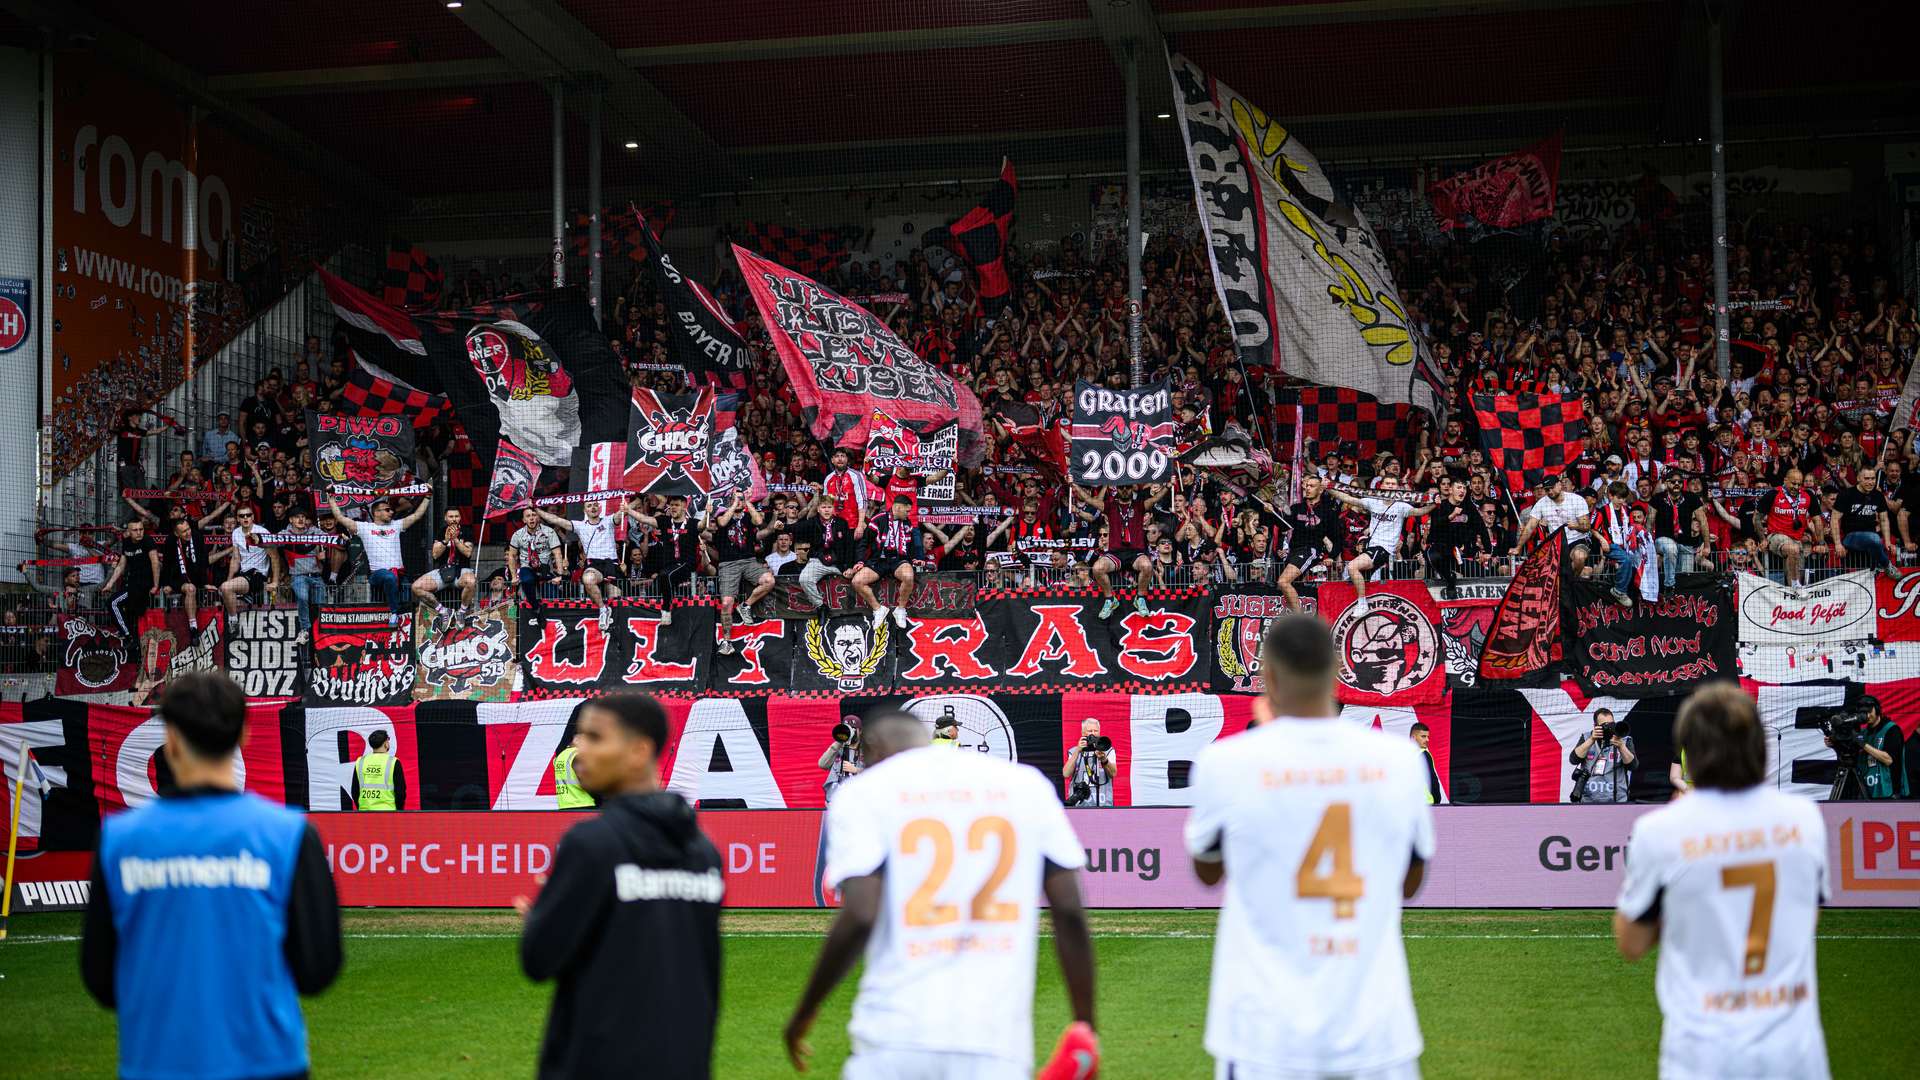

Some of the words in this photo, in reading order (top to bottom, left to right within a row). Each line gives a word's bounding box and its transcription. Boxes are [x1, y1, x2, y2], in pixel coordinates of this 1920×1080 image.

[677, 311, 732, 366] BAYER
[485, 374, 507, 393] 04
[318, 413, 403, 438] PIWO
[1082, 448, 1168, 480] 2009
[927, 487, 953, 499] FRAGE
[1071, 537, 1096, 548] LEV
[321, 612, 346, 624] SEKTION
[1366, 600, 1418, 622] NFERNO
[229, 640, 298, 669] SIDE
[422, 628, 510, 669] CHAOS
[481, 661, 506, 677] 513
[842, 680, 861, 689] UL
[362, 789, 382, 799] 2052
[899, 815, 1020, 927] 22
[1296, 802, 1364, 920] 4
[1720, 860, 1777, 978] 7
